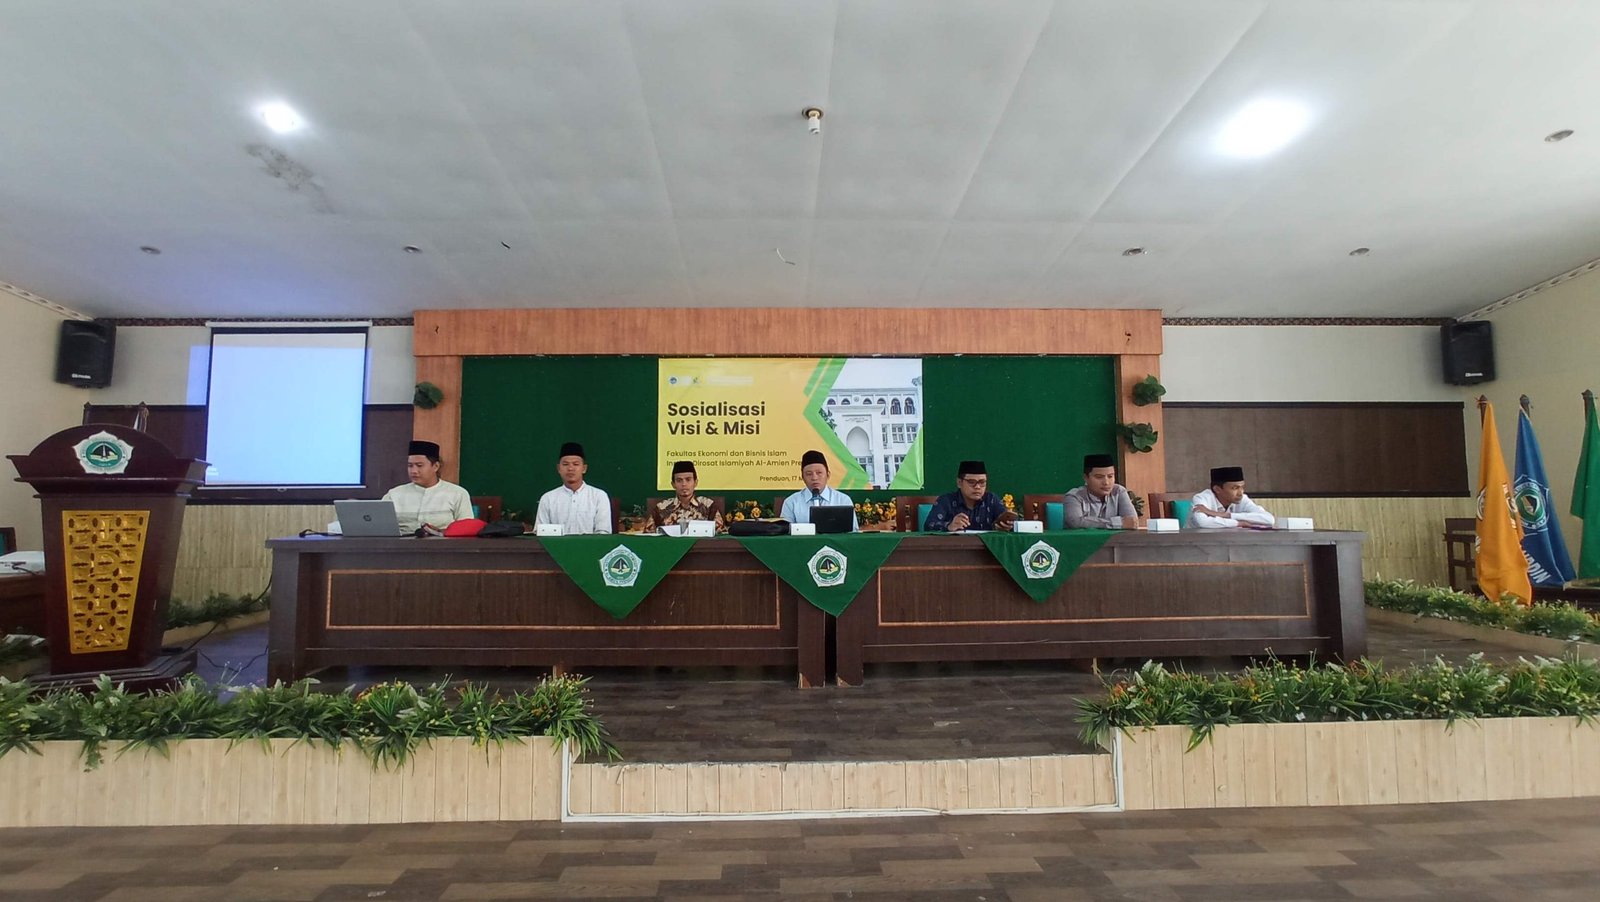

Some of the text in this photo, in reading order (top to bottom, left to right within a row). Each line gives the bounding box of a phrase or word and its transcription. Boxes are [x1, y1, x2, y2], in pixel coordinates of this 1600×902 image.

[667, 401, 765, 416] Sosialisasi
[667, 420, 760, 435] Visi & Misi
[719, 460, 755, 468] Islamiyah
